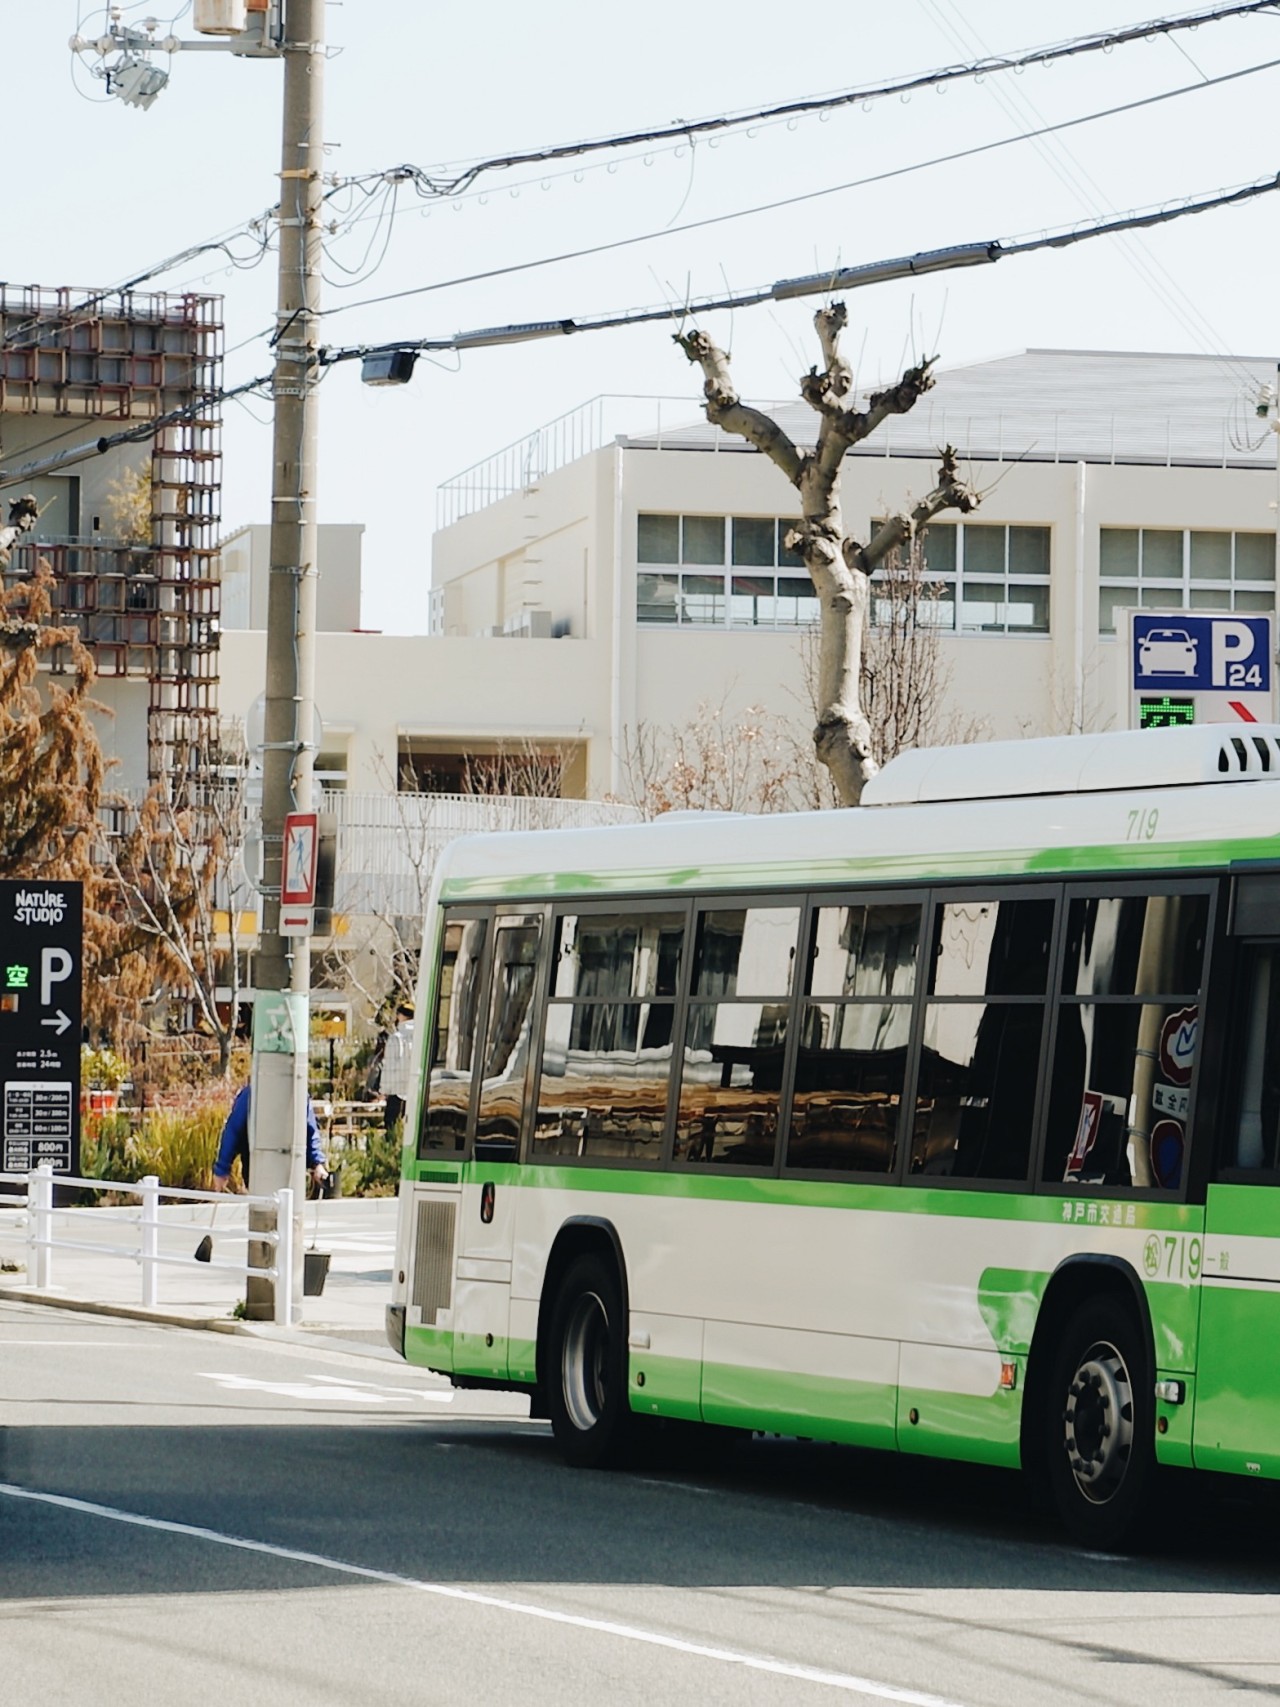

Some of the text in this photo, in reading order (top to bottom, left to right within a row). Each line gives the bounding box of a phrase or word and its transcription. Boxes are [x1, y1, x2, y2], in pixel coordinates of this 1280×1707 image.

[1126, 808, 1159, 841] 719
[15, 889, 68, 908] NATURE
[13, 907, 63, 926] STUDIO
[6, 964, 29, 987] 空
[41, 947, 73, 1005] P
[1062, 1201, 1136, 1226] 神戸市交通局
[1164, 1236, 1201, 1280] 719
